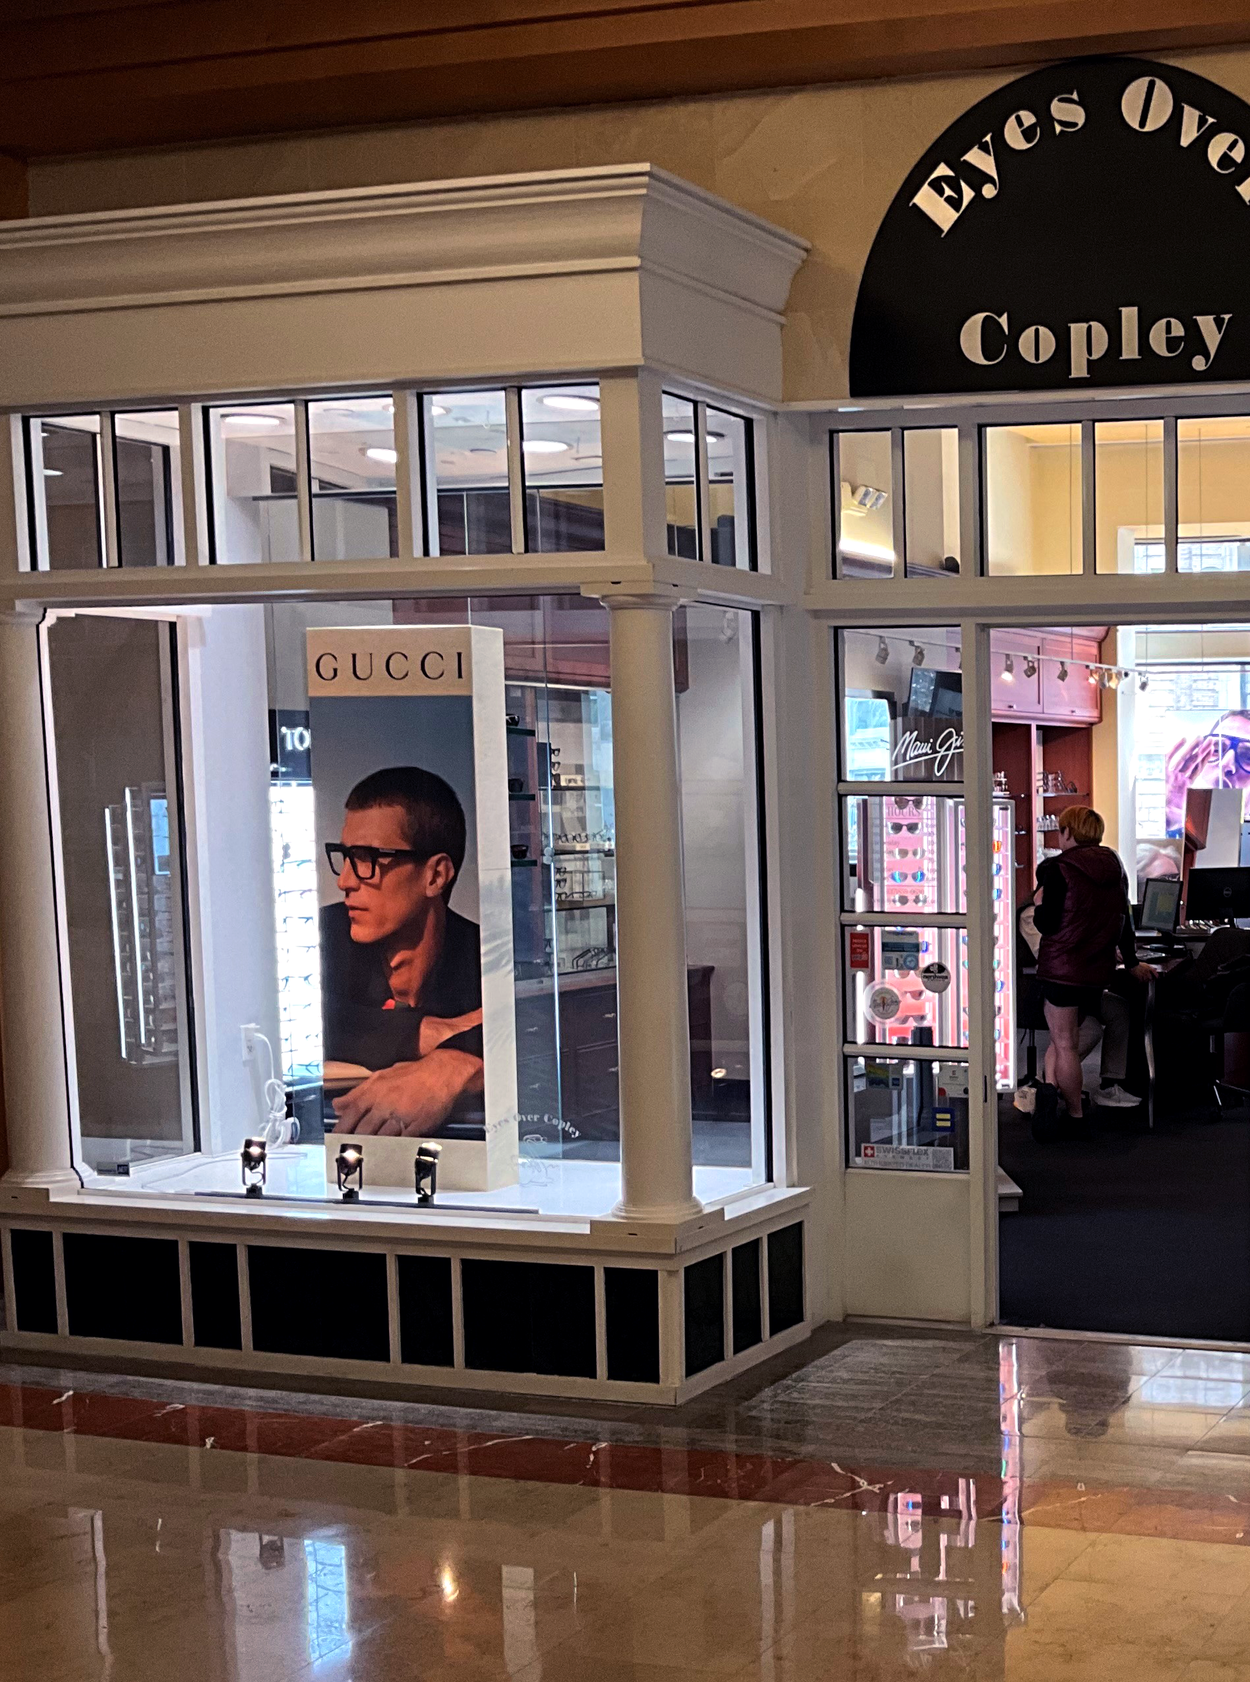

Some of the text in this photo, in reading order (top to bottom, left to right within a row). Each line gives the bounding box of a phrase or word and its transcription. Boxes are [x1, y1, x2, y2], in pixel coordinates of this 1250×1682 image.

[908, 89, 1087, 238] Eyes
[959, 306, 1233, 378] Copley
[315, 651, 464, 681] GUCCI
[892, 731, 933, 761] Maui
[543, 1113, 582, 1138] Copley
